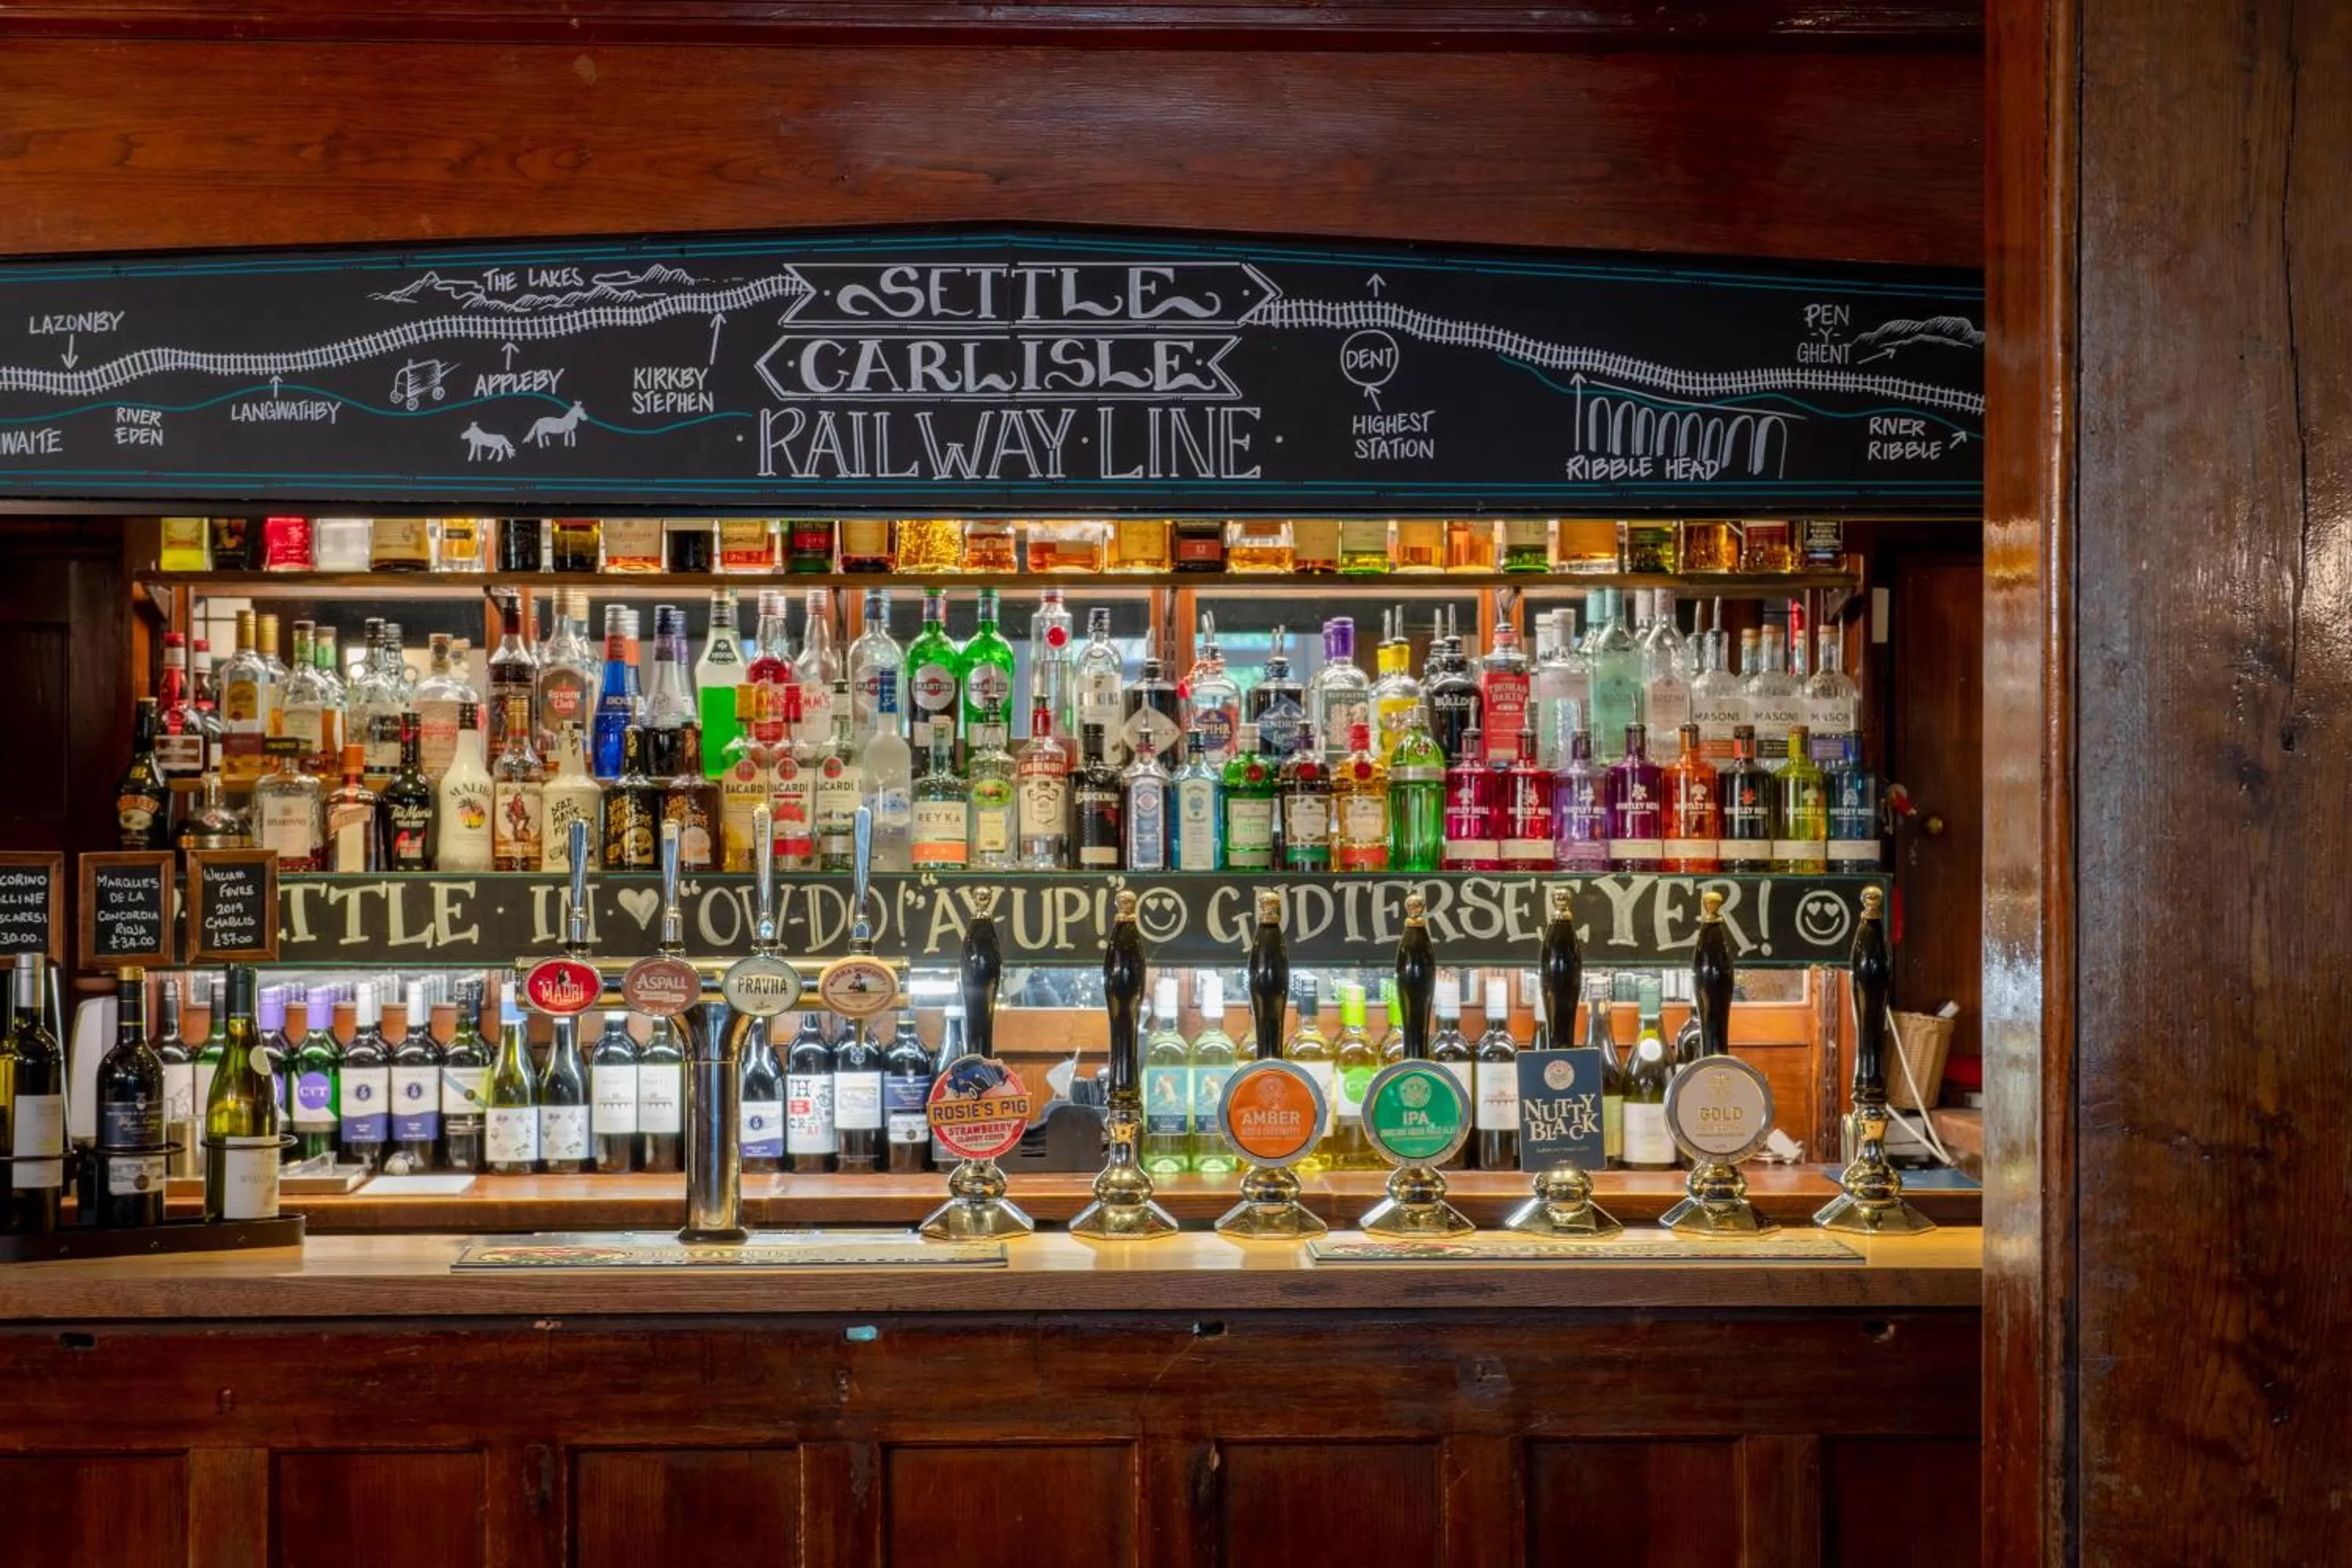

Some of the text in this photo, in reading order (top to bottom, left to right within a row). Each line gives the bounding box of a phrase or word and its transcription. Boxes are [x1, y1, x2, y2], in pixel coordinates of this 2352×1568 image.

[483, 266, 584, 292] THE LAKES
[837, 266, 1221, 320] SETTLE
[29, 310, 124, 336] LAZONBY
[1804, 304, 1849, 327] PEN
[1346, 347, 1393, 369] DENT
[1798, 343, 1853, 365] GHENT
[800, 338, 1216, 393] CARLISLE
[474, 368, 564, 397] APPLEBY
[633, 367, 709, 390] KIRKBY
[231, 401, 341, 424] LANGWATHBY
[632, 392, 713, 415] STEPHEN
[115, 407, 162, 426] RIVER
[1352, 409, 1436, 436] HIGHEST
[114, 427, 164, 446] EDEN
[757, 406, 1261, 480] RAILWAY LINE
[1355, 437, 1434, 460] STATION
[1867, 441, 1943, 461] RIBBLE
[1566, 456, 1720, 481] RIBBLE HEAD
[917, 811, 961, 823] REYKA
[96, 876, 159, 889] MARQUES
[110, 891, 145, 903] DE LA
[97, 910, 159, 922] CONCORDIA
[216, 903, 244, 914] 2019
[115, 924, 147, 935] RIOJA
[633, 975, 688, 991] ASPALL
[737, 976, 788, 995] PRAVHA
[933, 1100, 1028, 1120] ROSIE'S PIG
[1241, 1111, 1301, 1124] AMBER
[1403, 1110, 1429, 1125] IPA
[1522, 1093, 1596, 1123] NUTTY
[1700, 1107, 1743, 1121] GOLD
[948, 1122, 1012, 1137] STRAWBERRY
[1529, 1110, 1599, 1142] BLACK
